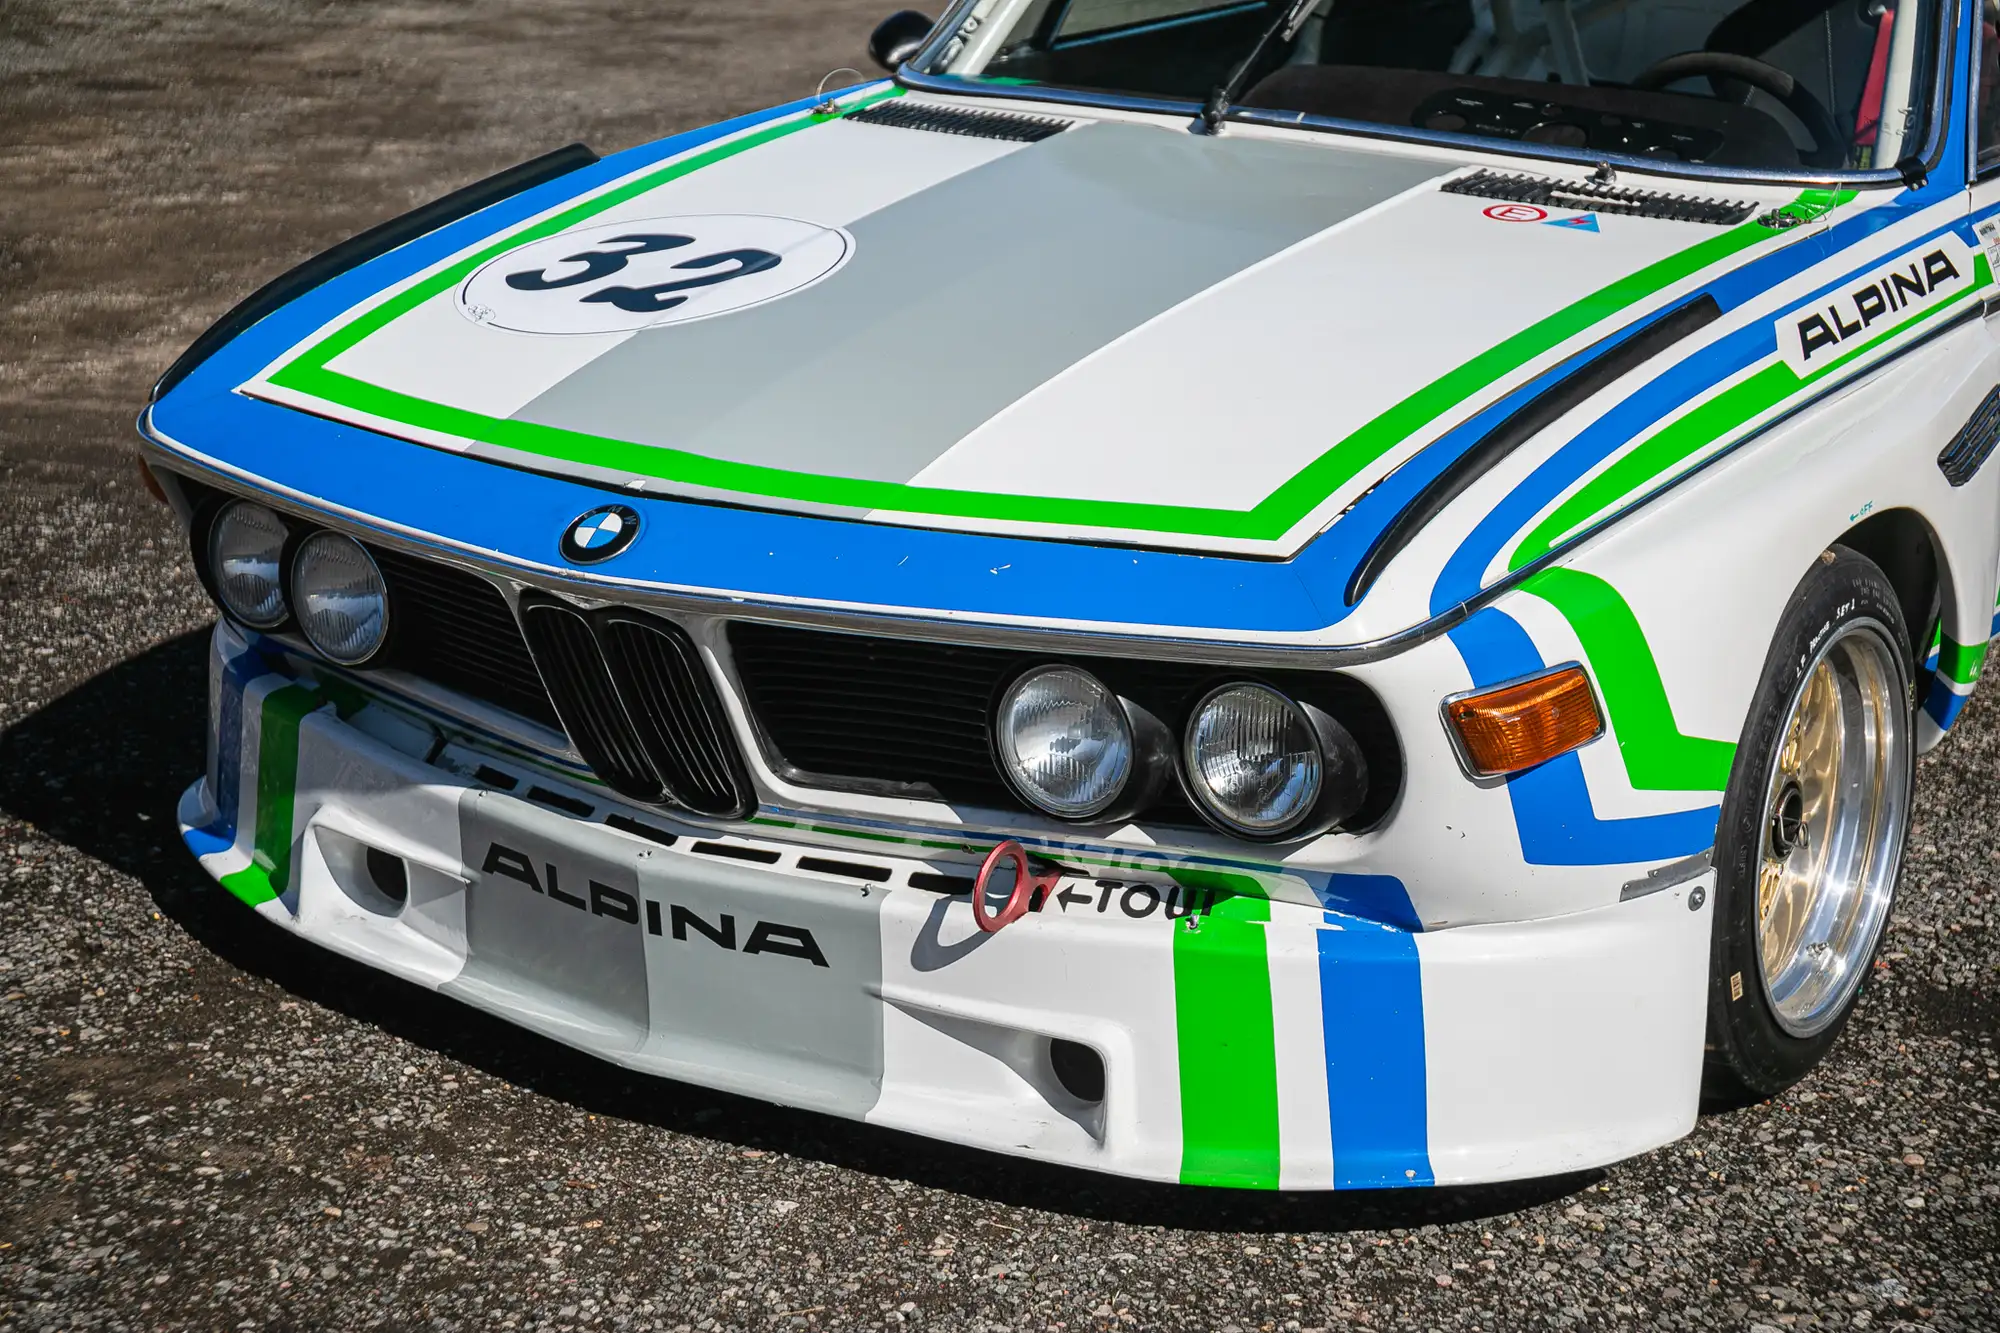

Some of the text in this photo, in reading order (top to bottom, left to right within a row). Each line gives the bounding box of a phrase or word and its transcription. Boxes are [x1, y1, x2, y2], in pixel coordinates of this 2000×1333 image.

[505, 234, 783, 313] 32
[1797, 249, 1960, 361] ALPINA
[482, 842, 830, 968] ALPINA
